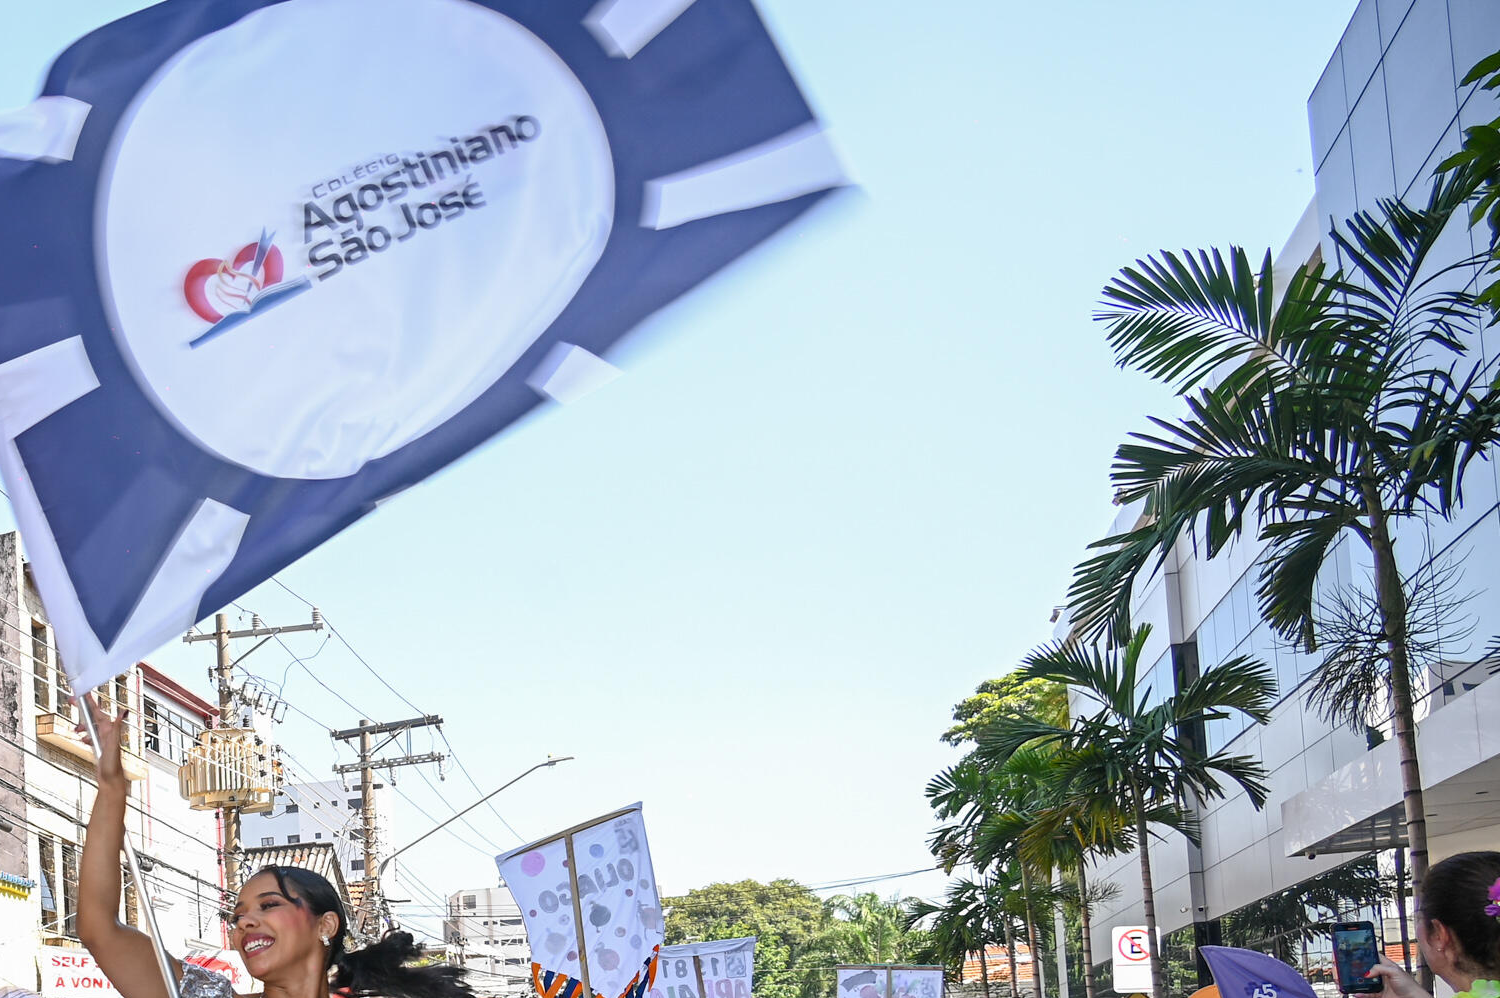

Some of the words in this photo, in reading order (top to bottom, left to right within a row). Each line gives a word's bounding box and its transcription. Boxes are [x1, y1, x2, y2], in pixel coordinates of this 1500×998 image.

[303, 115, 542, 244] Agostiniano
[312, 153, 400, 199] COLÉGIO
[308, 225, 392, 282] São
[397, 173, 487, 242] José
[52, 955, 89, 968] SELF
[1131, 936, 1142, 954] E
